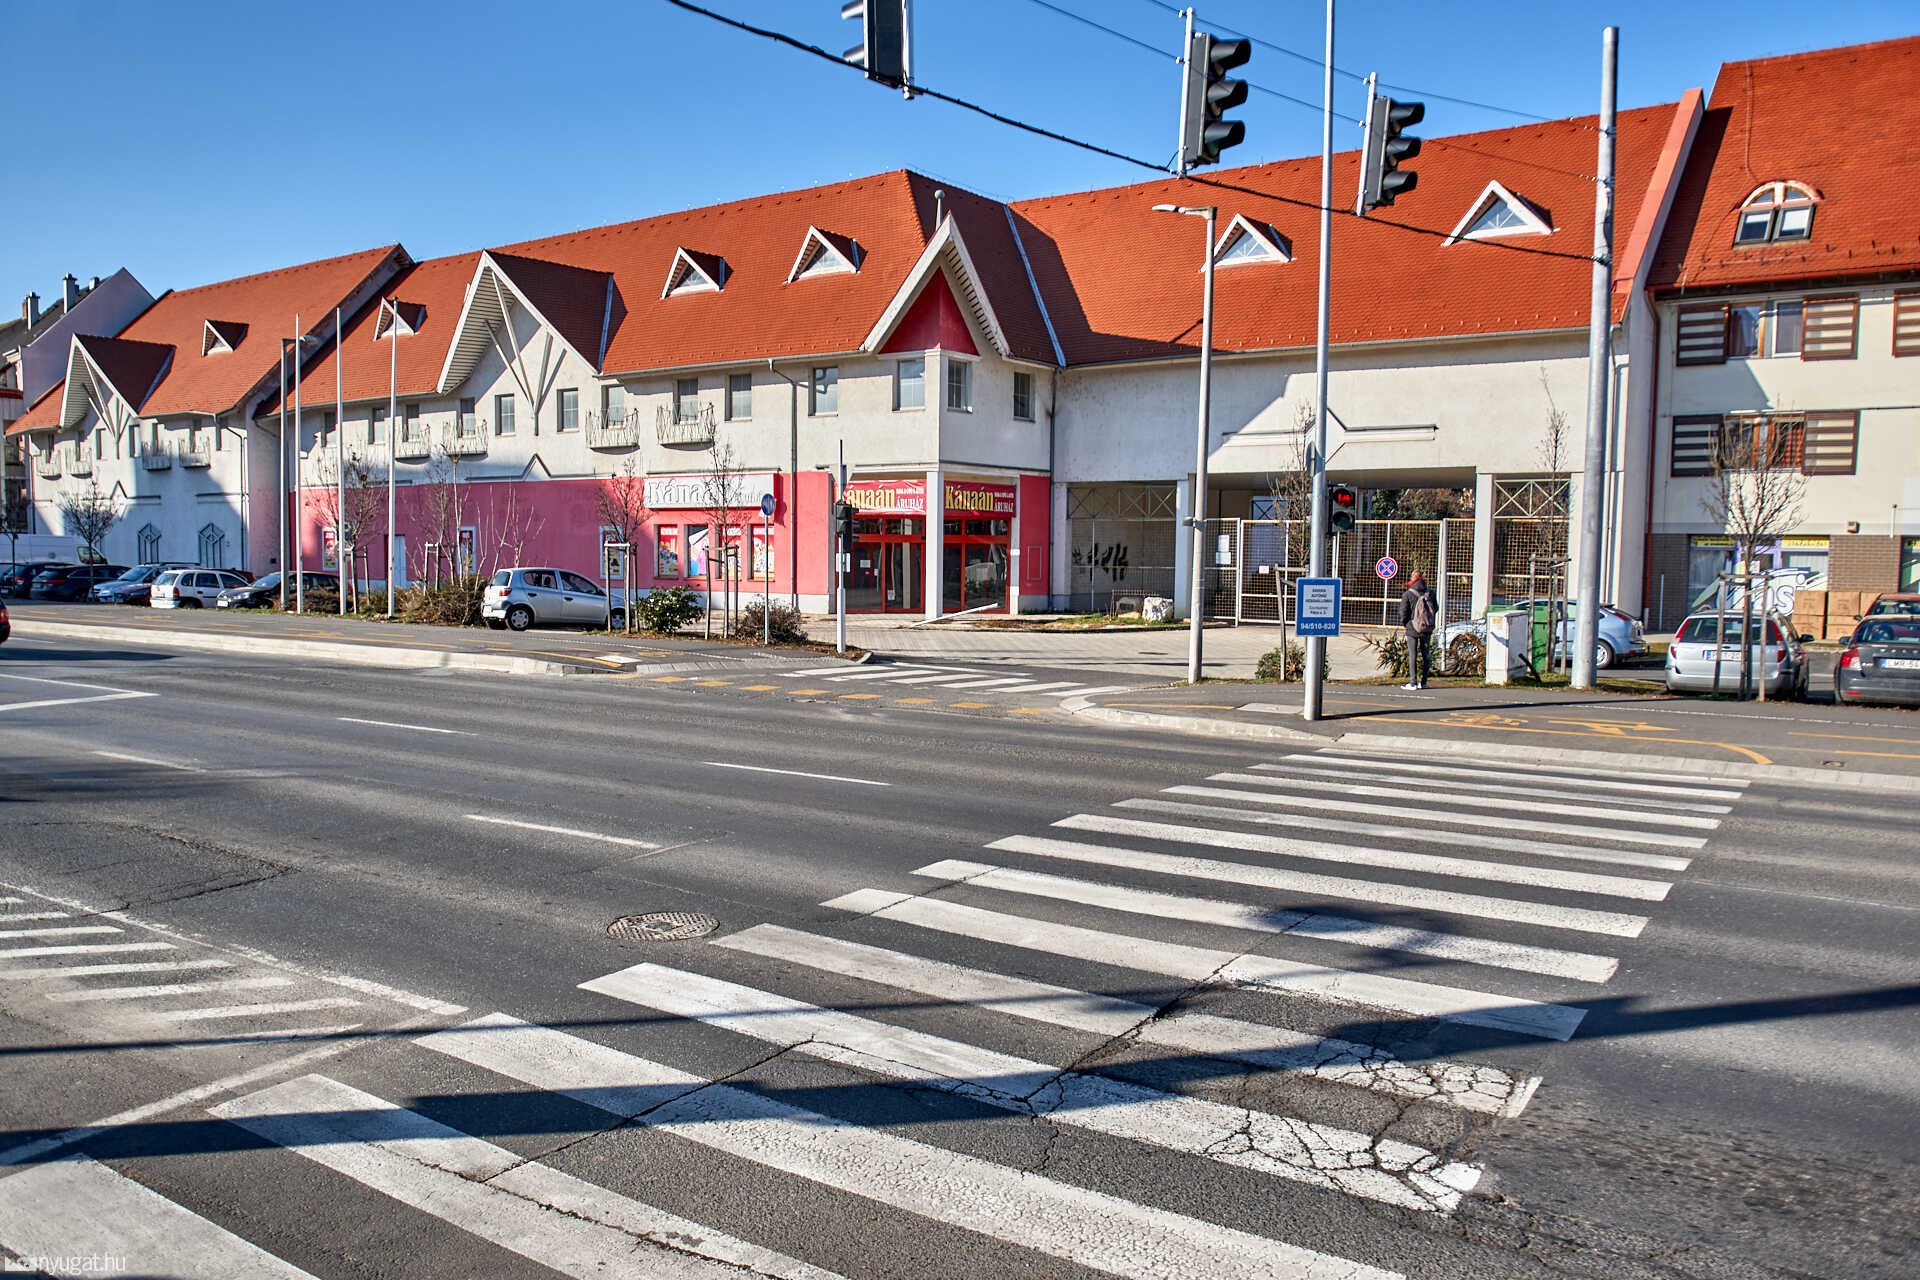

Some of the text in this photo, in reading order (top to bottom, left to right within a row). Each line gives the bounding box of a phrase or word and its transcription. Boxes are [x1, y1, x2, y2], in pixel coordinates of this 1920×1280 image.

[845, 485, 895, 509] ánaán
[896, 495, 924, 509] ÁRUHÁZ
[945, 485, 994, 512] Kánaán
[994, 499, 1014, 512] ÁRUHÁZ
